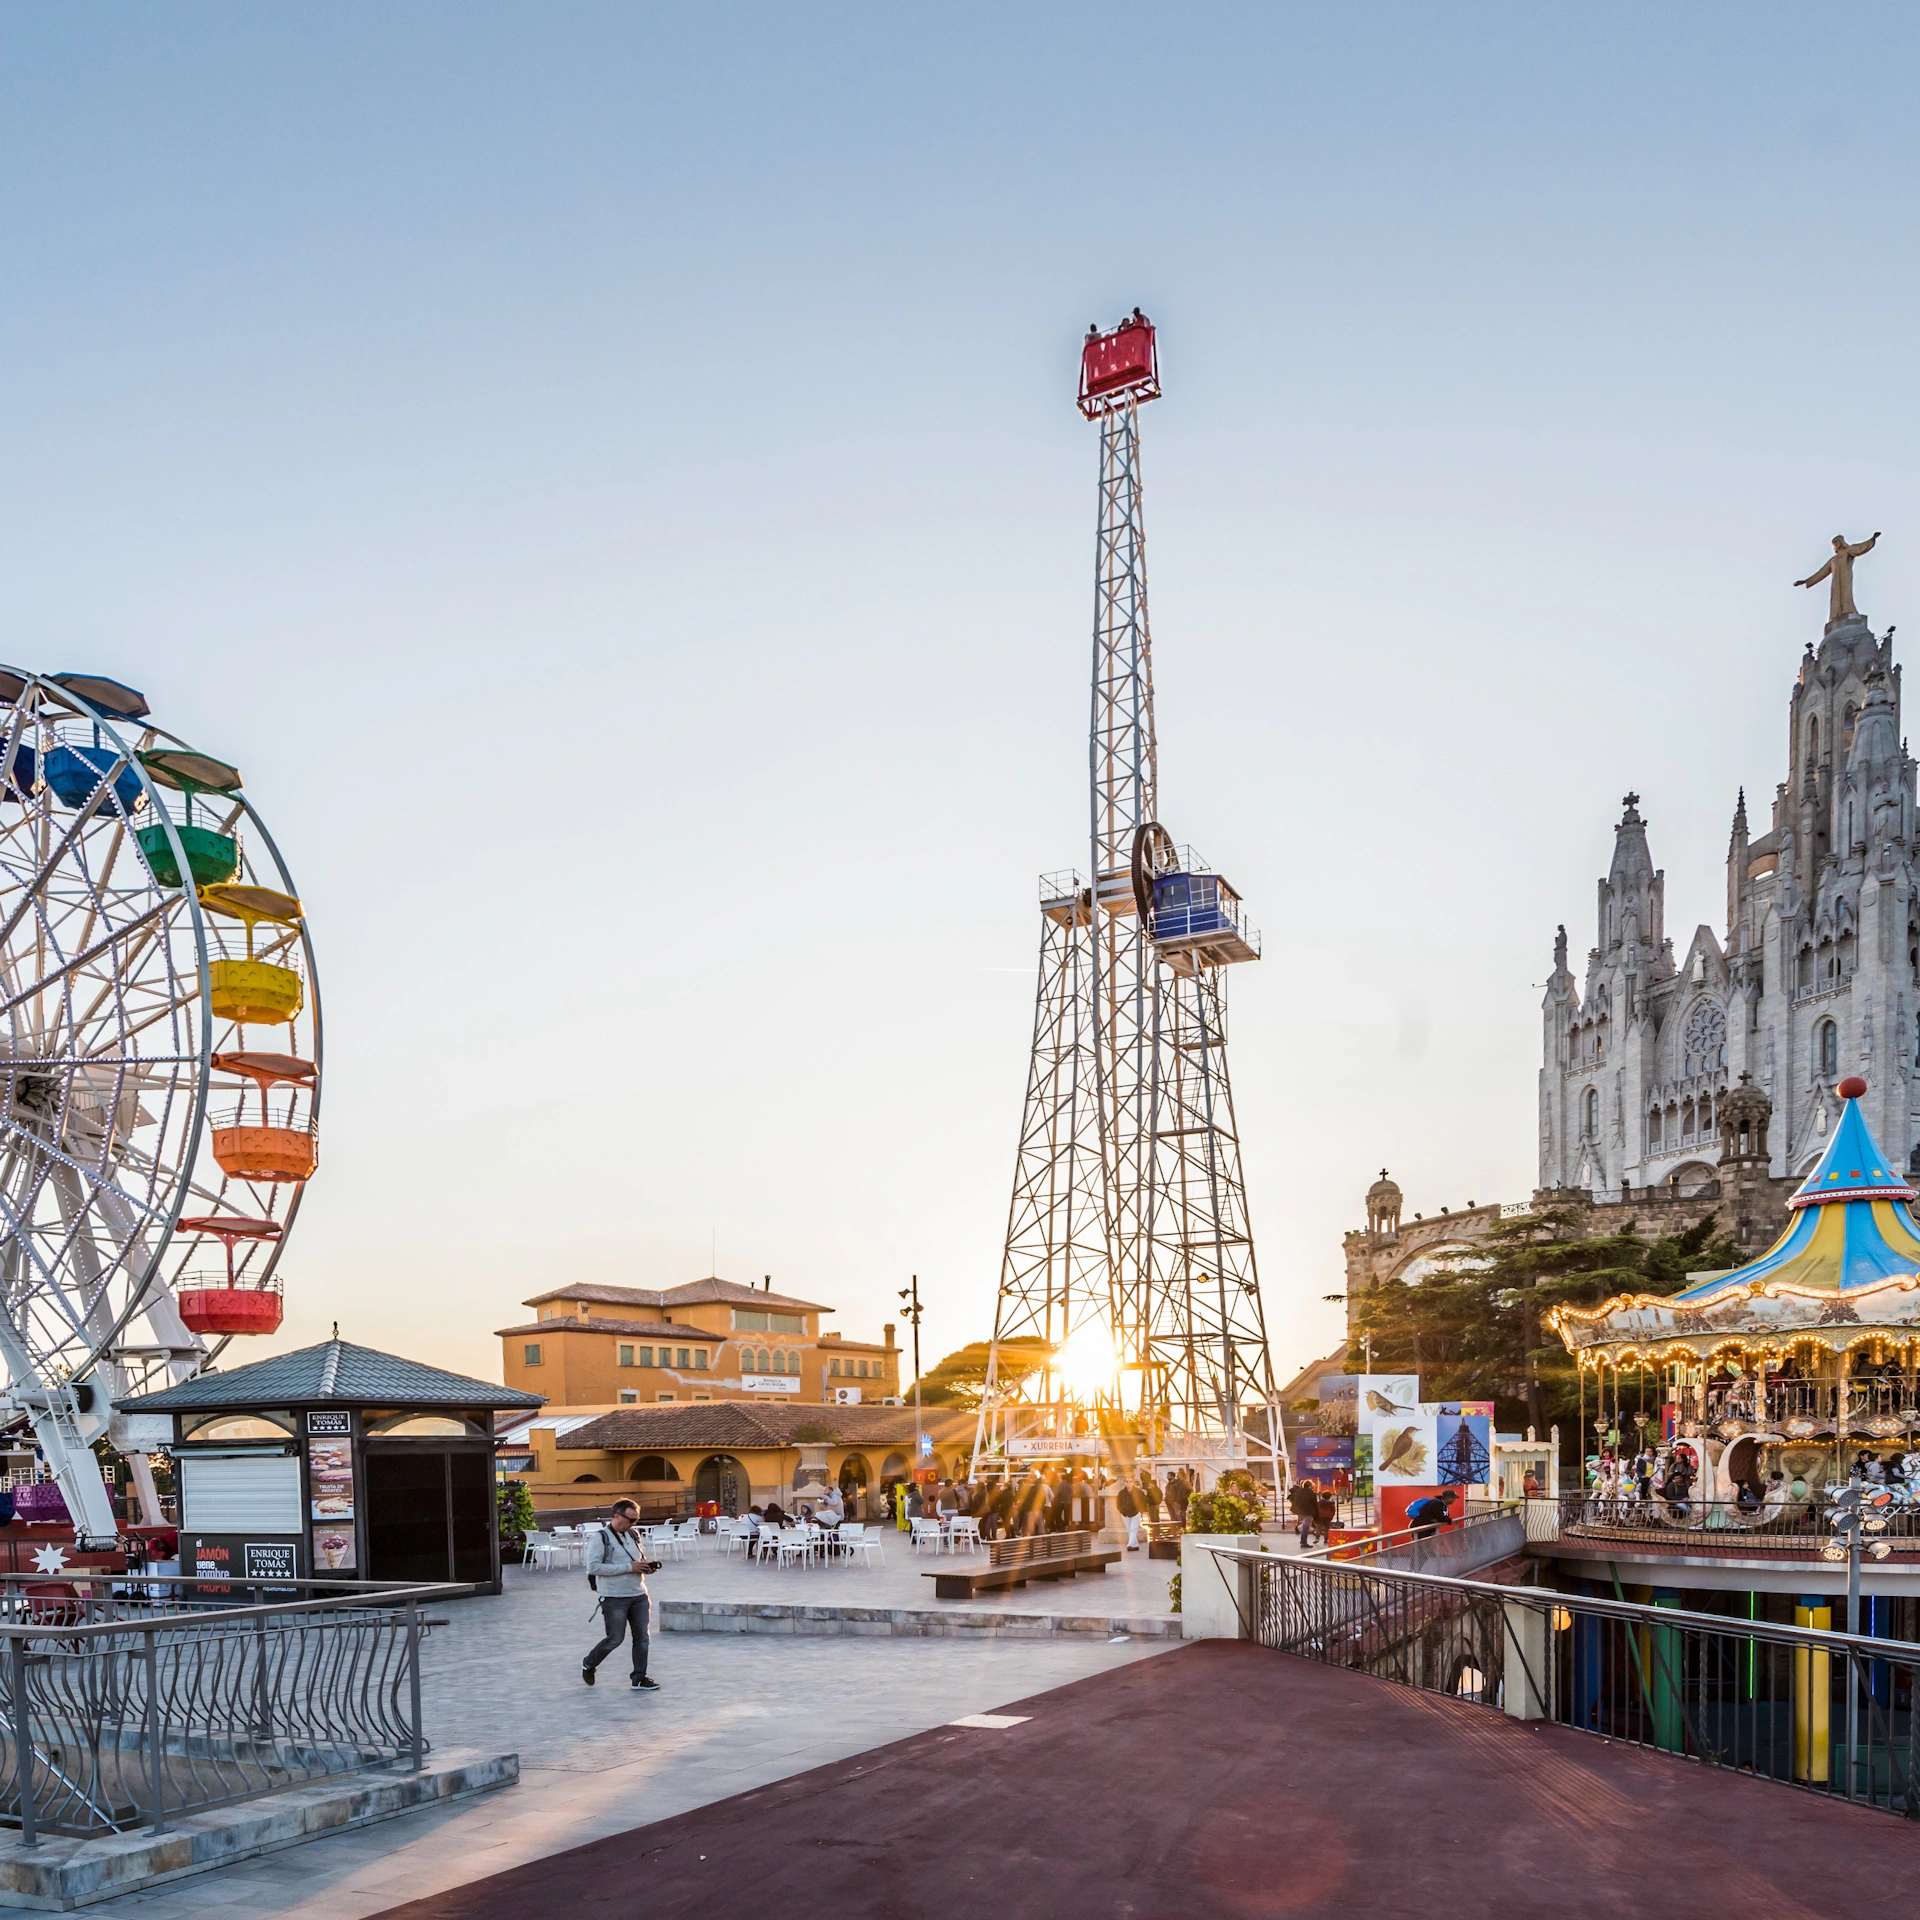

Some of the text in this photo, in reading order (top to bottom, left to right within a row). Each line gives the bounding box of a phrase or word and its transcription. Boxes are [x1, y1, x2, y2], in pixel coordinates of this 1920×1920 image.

[1031, 1441, 1073, 1451] XURRERIA
[196, 1539, 202, 1548] el
[196, 1545, 229, 1560] JAMÓN
[250, 1549, 291, 1560] ENRIQUE
[196, 1560, 216, 1570] tiene
[196, 1568, 230, 1578] nombre
